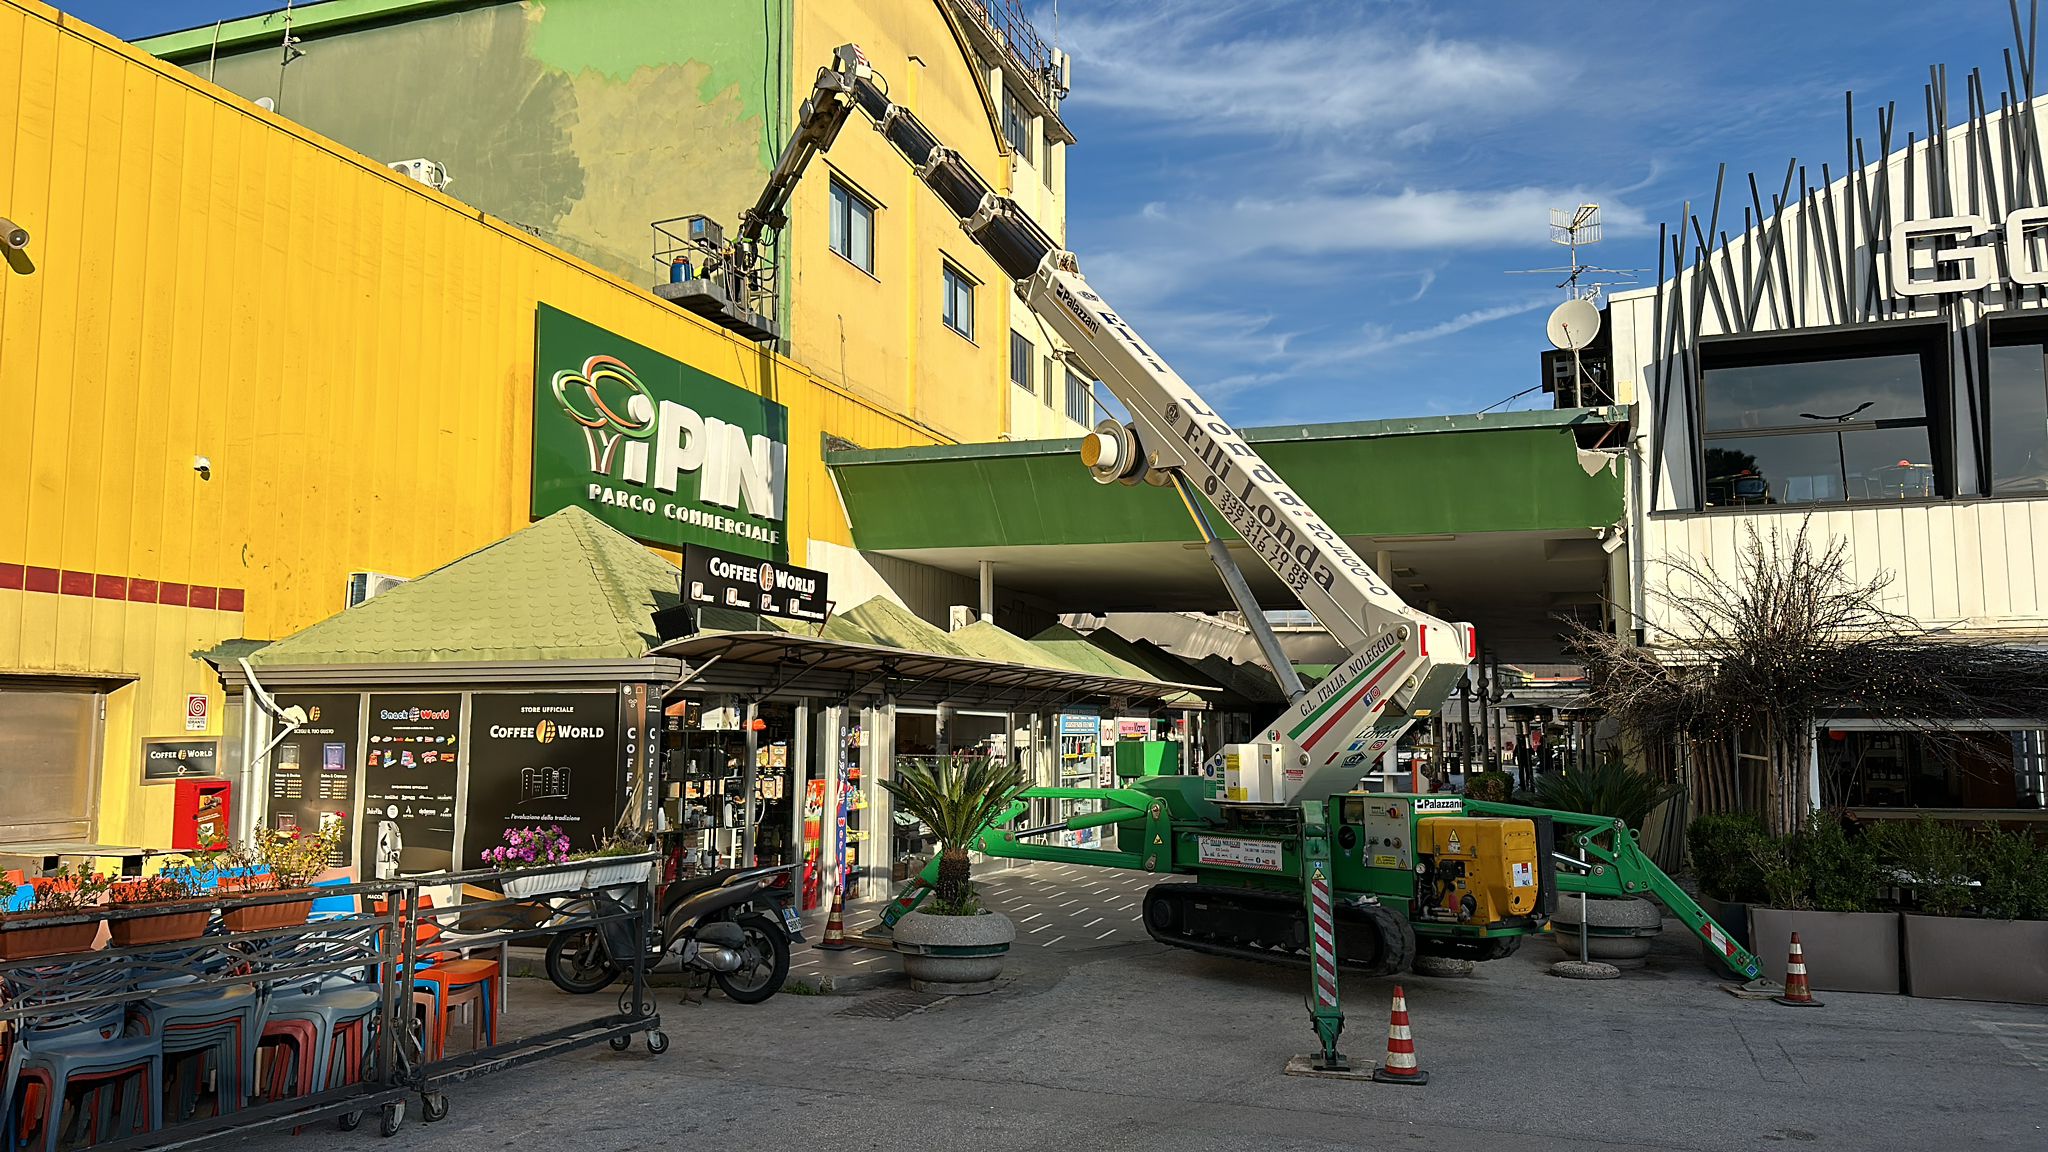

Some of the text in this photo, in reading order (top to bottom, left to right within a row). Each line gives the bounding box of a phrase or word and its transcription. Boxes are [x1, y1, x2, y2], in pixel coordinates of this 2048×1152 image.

[1062, 291, 1101, 335] Palazzani
[1181, 397, 1304, 507] Londa
[588, 483, 780, 545] PARCO COMMERCIALE
[1183, 418, 1335, 594] F.lli Londa
[1218, 501, 1304, 595] 327 318 71 92
[1222, 490, 1309, 585] 338 317 10 88
[1306, 523, 1388, 595] NOLEGGIO
[709, 557, 816, 595] COFFEE WORLD
[1300, 632, 1395, 717] G.L. ITALIA NOLEGGIO
[380, 709, 450, 720] Snack World
[489, 724, 605, 738] COFFEE WORLD
[150, 749, 213, 760] COFFEE WORLD
[646, 727, 656, 810] COFFEE
[1424, 799, 1462, 809] Palazzani
[1641, 881, 1648, 889] 3
